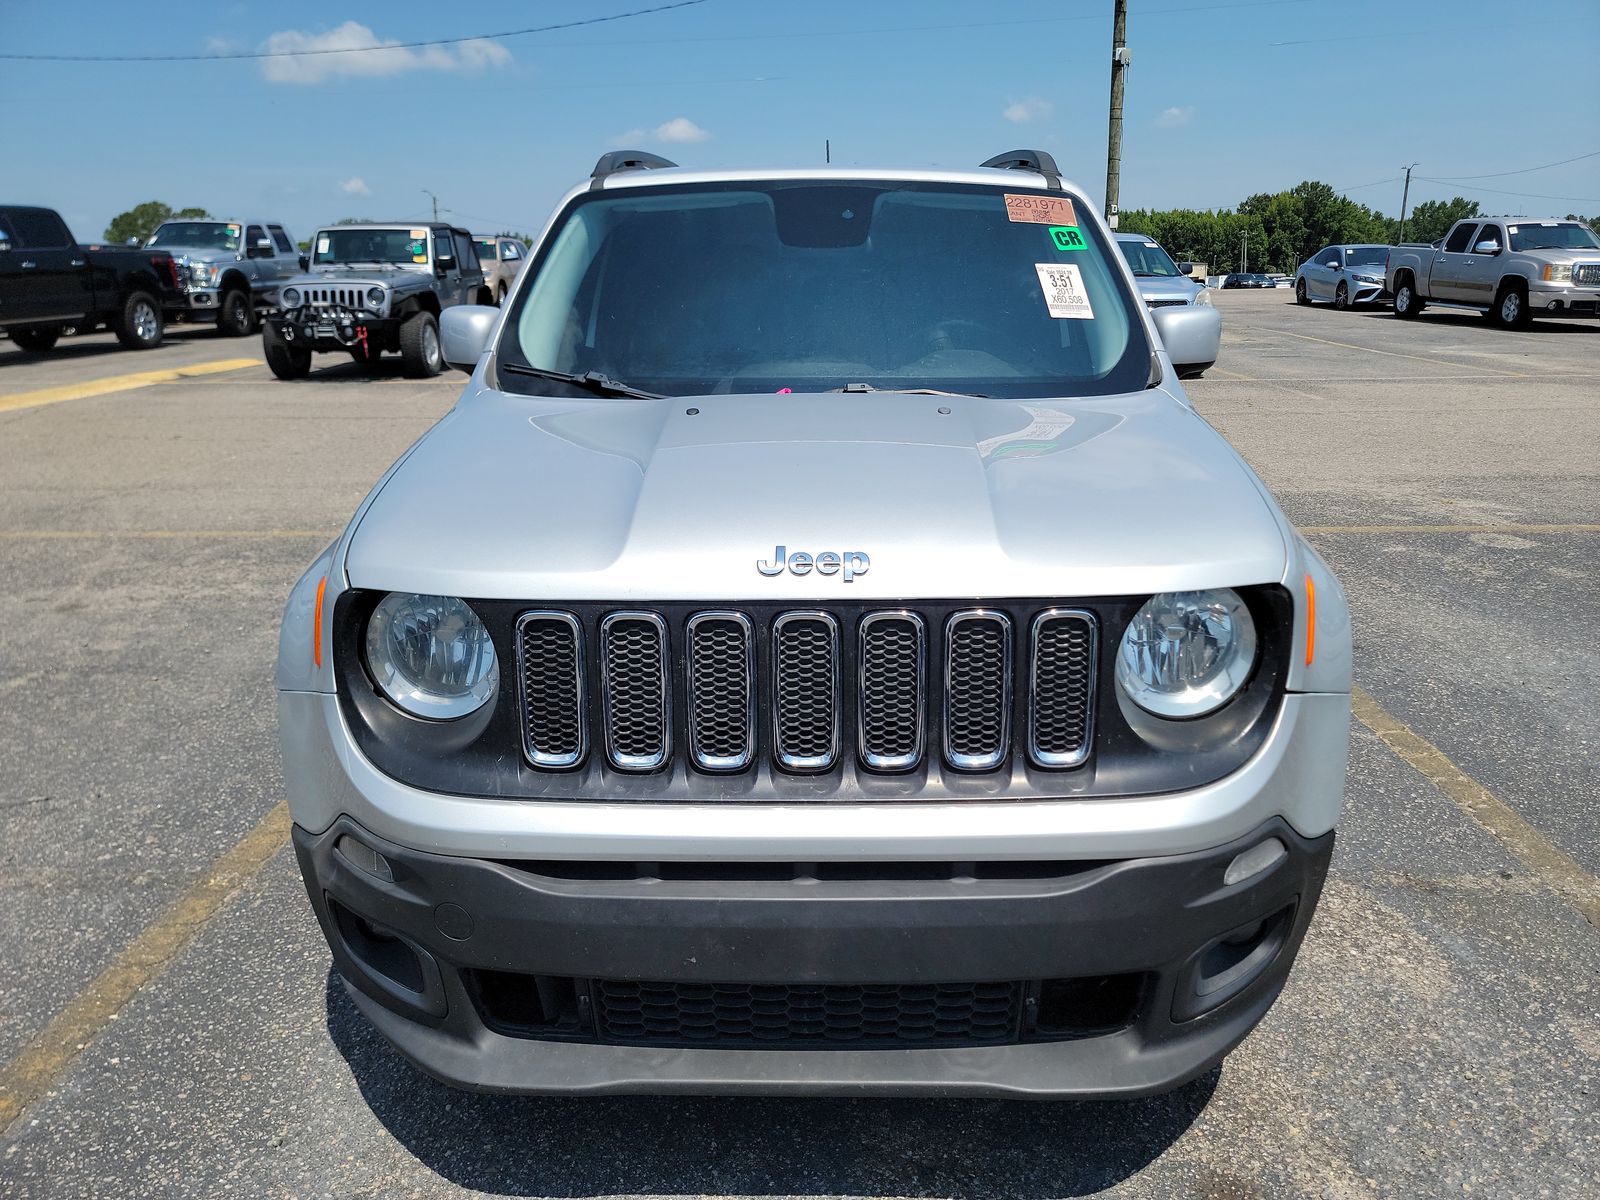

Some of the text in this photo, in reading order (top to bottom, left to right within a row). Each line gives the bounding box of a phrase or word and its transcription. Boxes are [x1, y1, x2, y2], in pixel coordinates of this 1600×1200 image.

[1006, 197, 1064, 211] 2281971
[1054, 231, 1083, 246] CR
[1050, 274, 1073, 288] 3:51
[1056, 287, 1074, 295] 2017
[757, 545, 870, 583] Jeep
